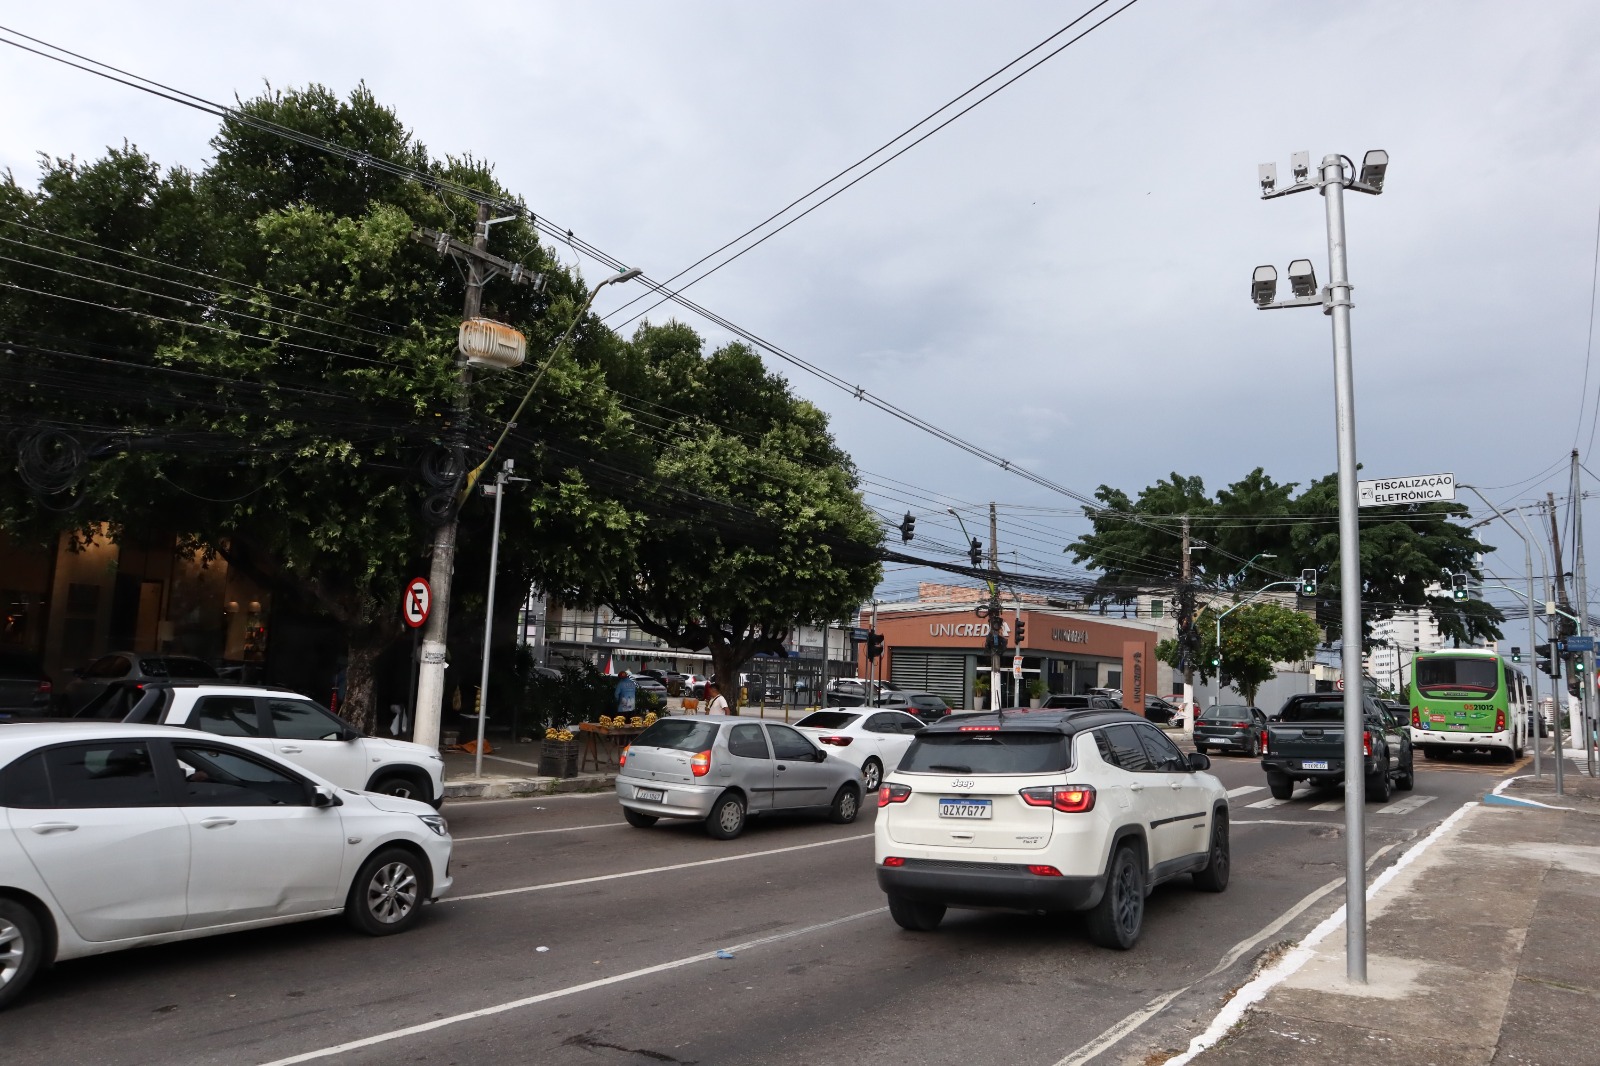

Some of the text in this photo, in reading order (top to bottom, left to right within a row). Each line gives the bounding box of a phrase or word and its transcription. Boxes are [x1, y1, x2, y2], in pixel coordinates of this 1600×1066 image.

[1375, 476, 1452, 491] FISCALIZAÇÃO
[1375, 490, 1442, 503] ELETRÔNICA
[929, 623, 991, 637] UNICRED
[1464, 703, 1494, 711] 0521012
[951, 779, 975, 789] Jeep
[943, 804, 986, 817] QZX7G77
